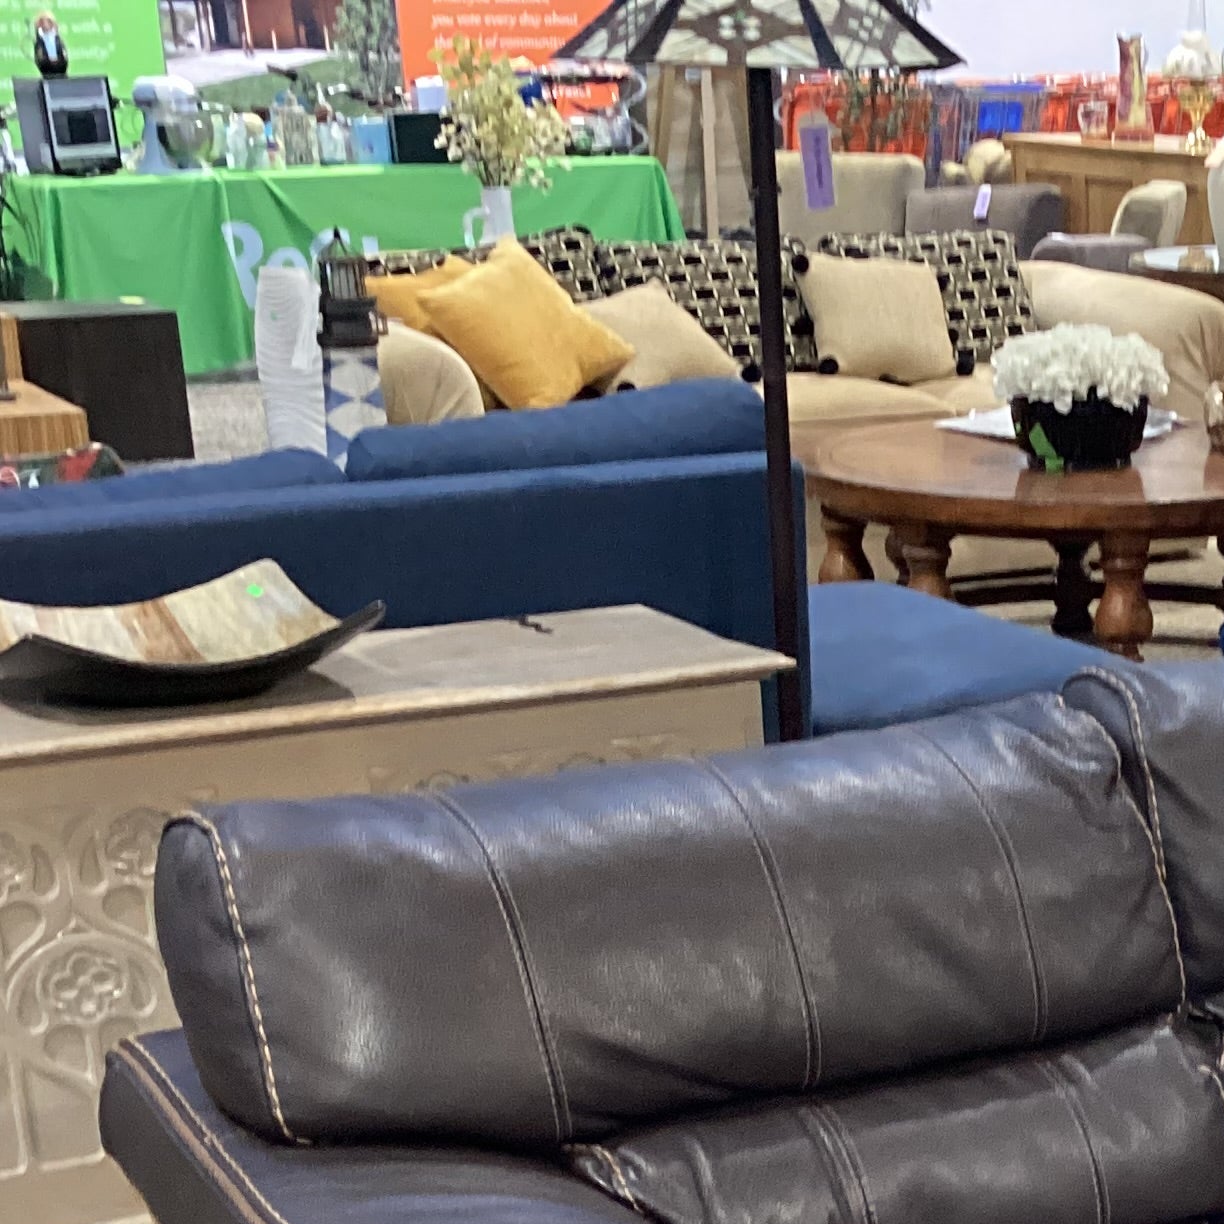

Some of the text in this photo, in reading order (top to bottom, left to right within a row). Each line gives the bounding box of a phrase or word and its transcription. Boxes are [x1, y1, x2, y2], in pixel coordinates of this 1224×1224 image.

[432, 10, 578, 29] you vote every day about
